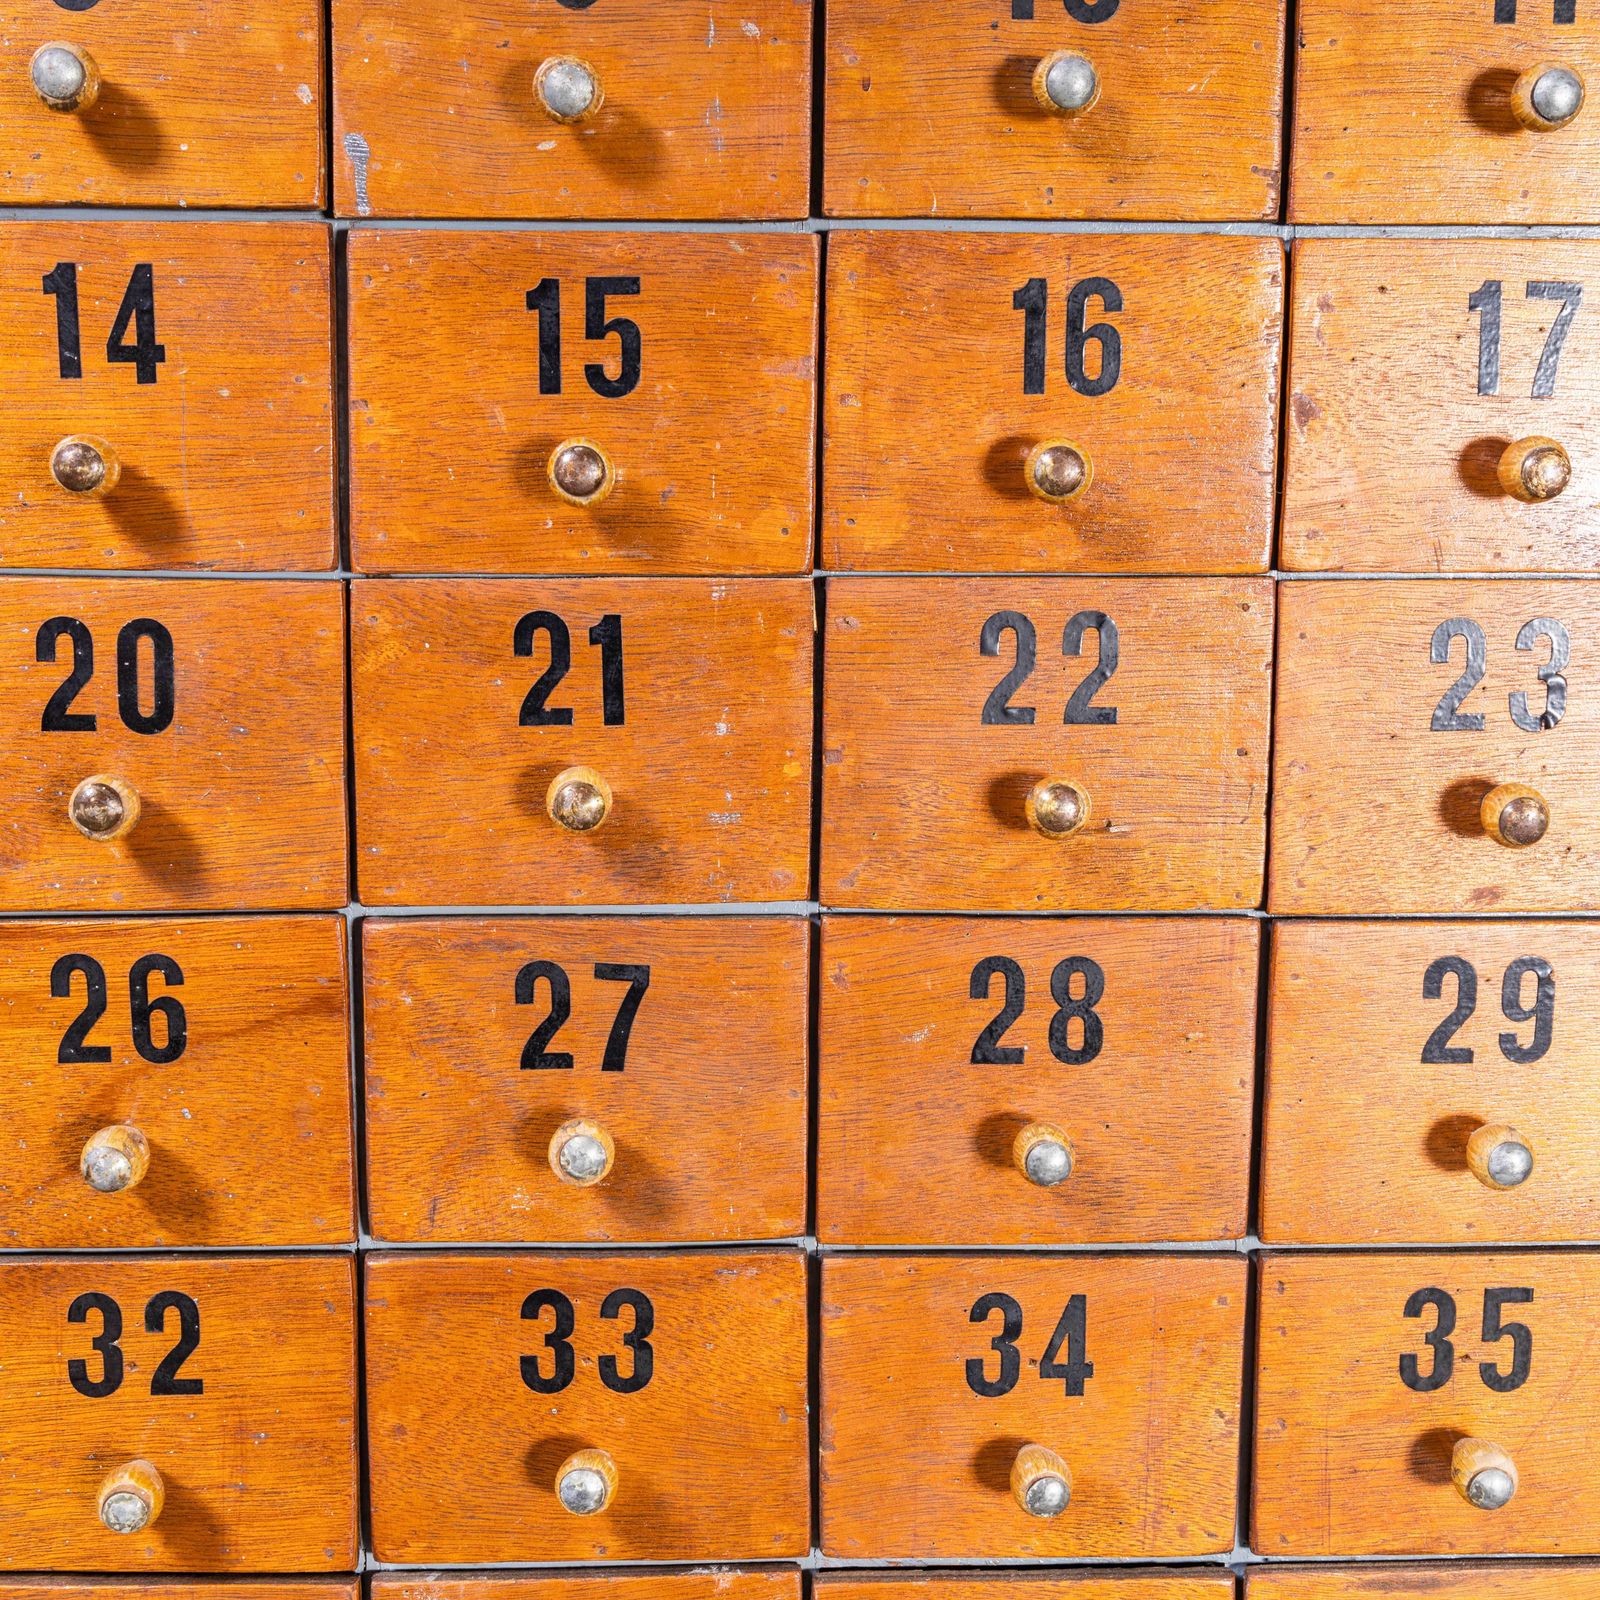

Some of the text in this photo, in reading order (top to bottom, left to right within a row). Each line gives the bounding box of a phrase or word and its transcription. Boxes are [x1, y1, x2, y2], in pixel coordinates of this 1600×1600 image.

[42, 262, 165, 384] 14
[525, 276, 641, 398] 15
[1012, 277, 1123, 396] 16
[1468, 280, 1583, 398] 17
[35, 616, 174, 735] 20
[513, 610, 625, 726] 21
[979, 610, 1119, 725] 22
[1428, 617, 1569, 732] 23
[50, 953, 187, 1064] 26
[514, 959, 651, 1072] 27
[969, 955, 1105, 1065] 28
[1420, 956, 1556, 1064] 29
[67, 1290, 204, 1398] 32
[519, 1288, 654, 1394] 33
[965, 1292, 1093, 1397] 34
[1399, 1287, 1534, 1392] 35
